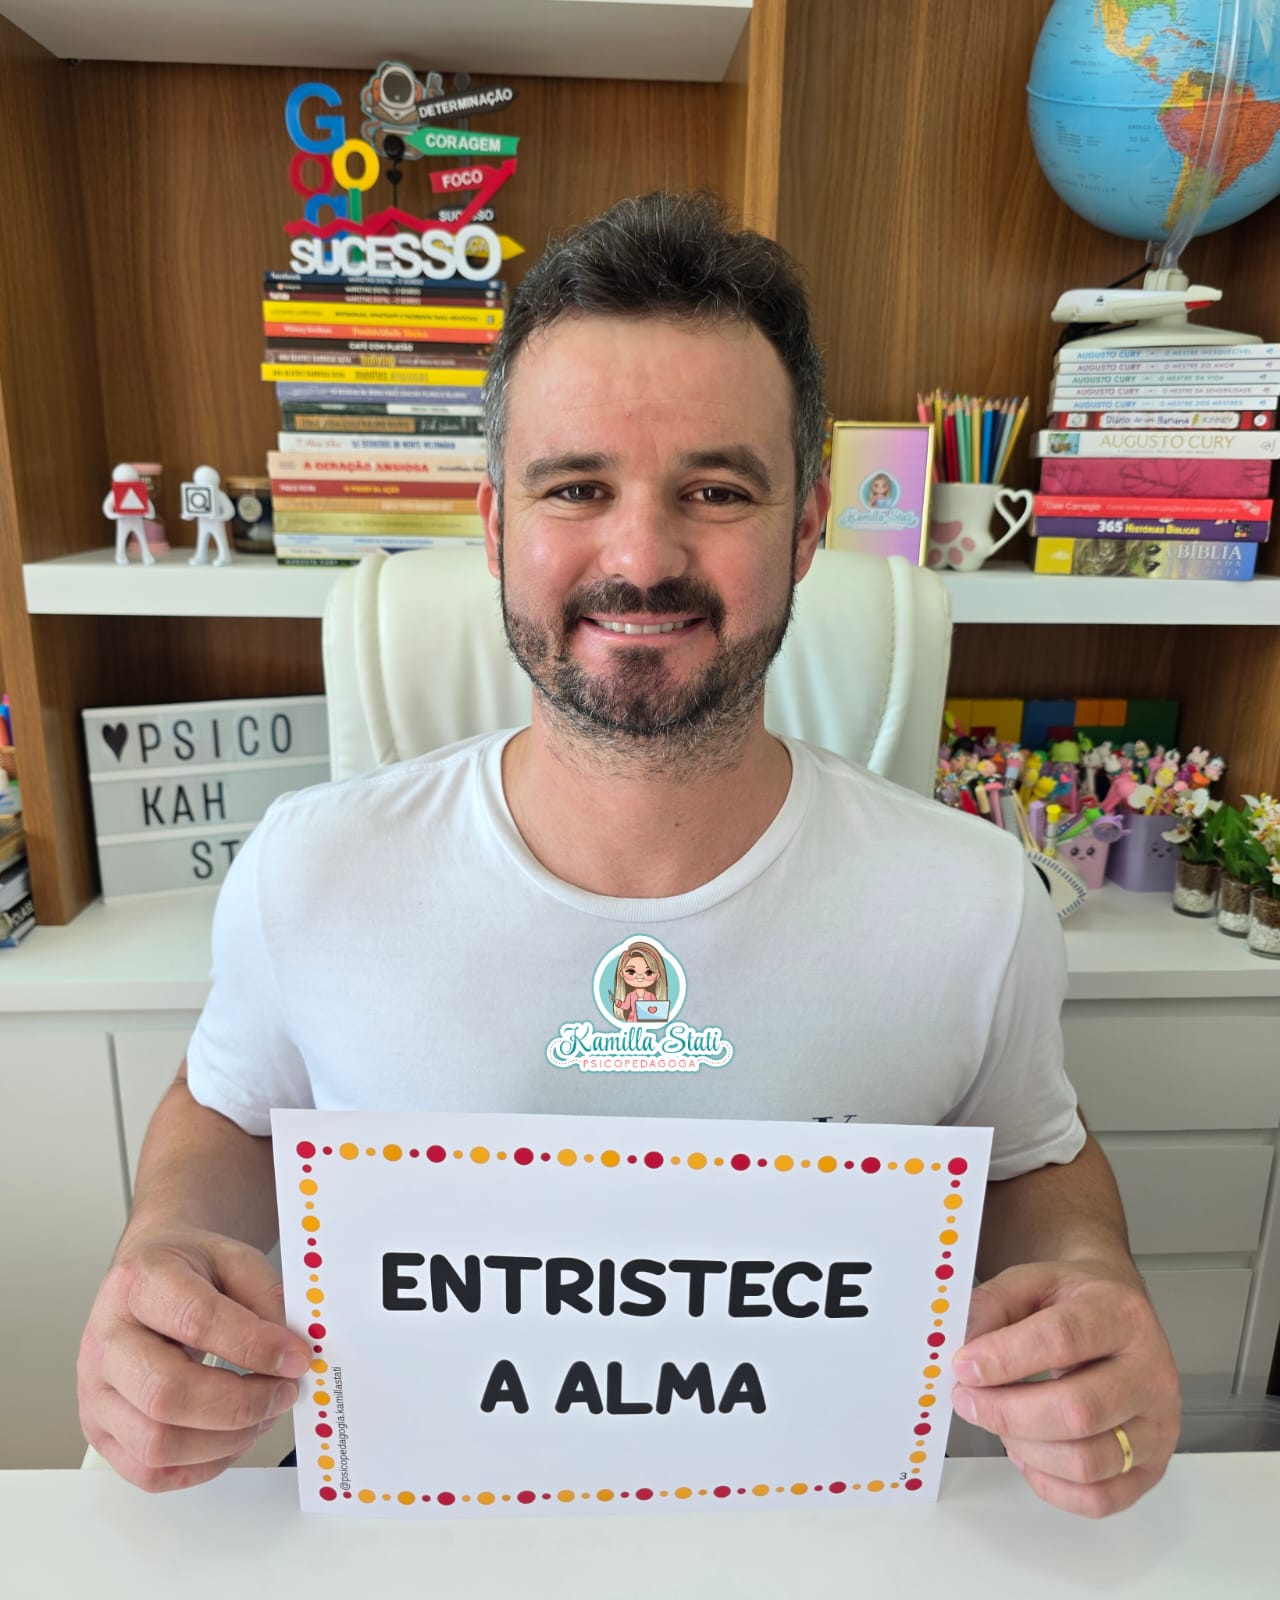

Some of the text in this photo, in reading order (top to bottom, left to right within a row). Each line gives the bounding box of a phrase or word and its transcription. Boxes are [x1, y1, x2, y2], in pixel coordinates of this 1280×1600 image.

[418, 87, 513, 119] DETERMINAÇÃO
[425, 132, 501, 153] CORAGEM
[441, 168, 484, 189] FOCO
[290, 224, 502, 281] SUCESSO
[1076, 351, 1118, 360] AUGUSTO
[1118, 350, 1142, 359] CURY
[1076, 364, 1118, 372] AUGUSTO
[1118, 363, 1142, 372] CURY
[1213, 361, 1235, 369] AMOR
[1072, 375, 1112, 385] AUGUSTO
[1113, 375, 1137, 384] CURY
[1075, 388, 1116, 396] AUGUSTO
[1117, 387, 1140, 395] CURY
[1072, 400, 1114, 410] AUGUSTO
[1114, 399, 1137, 409] CURY
[1105, 414, 1131, 425] Diário
[1157, 415, 1190, 426] Banana
[1099, 433, 1237, 450] AUGUSTO CURY
[303, 461, 312, 471] A
[314, 459, 373, 474] GERAÇÃO
[375, 462, 430, 473] ANSIOSA
[1065, 502, 1101, 513] Carnegie
[1097, 519, 1124, 533] 365
[1176, 541, 1242, 561] BÍBLIA
[138, 713, 293, 764] PSICO
[142, 781, 226, 826] KAH
[382, 1251, 873, 1319] ENTRISTECE
[480, 1359, 768, 1416] A ALMA
[331, 1365, 352, 1491] @psicopedagogia.kamillastati
[898, 1471, 908, 1481] 3
